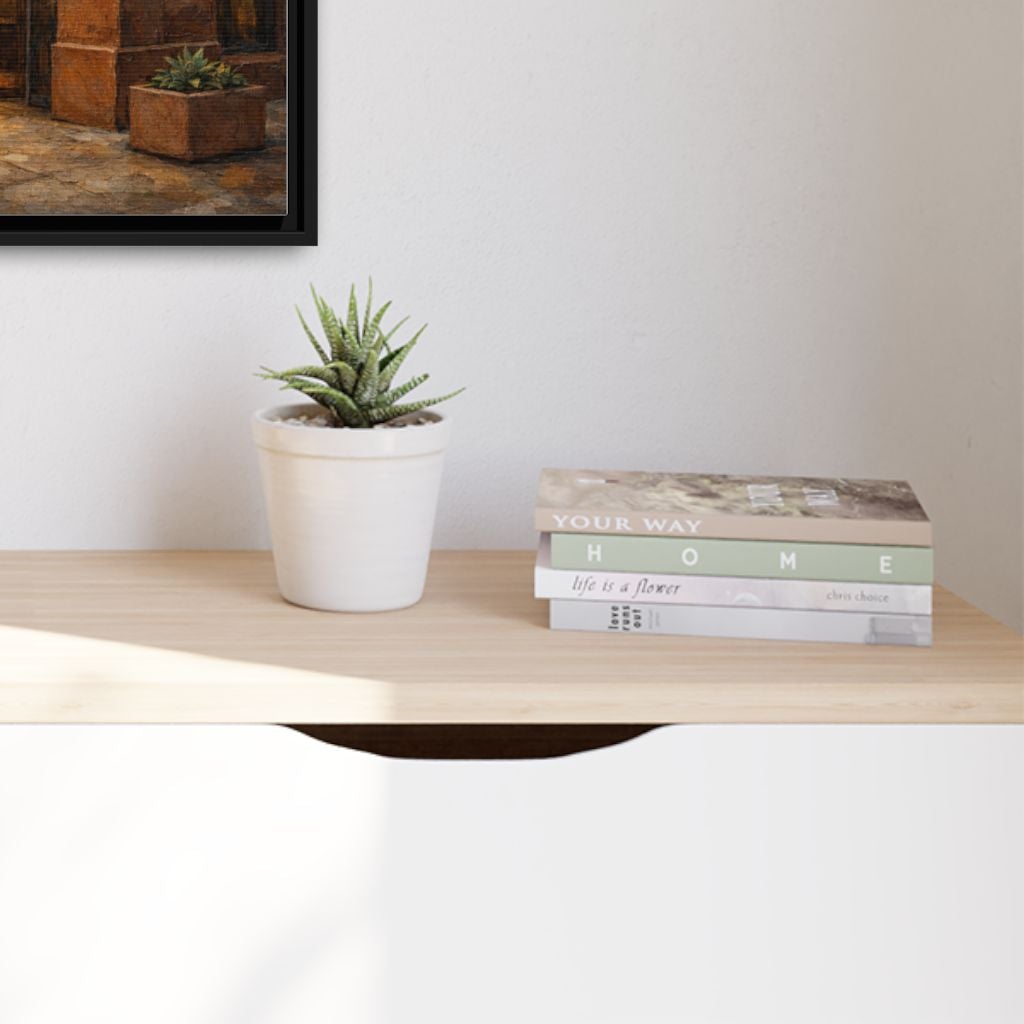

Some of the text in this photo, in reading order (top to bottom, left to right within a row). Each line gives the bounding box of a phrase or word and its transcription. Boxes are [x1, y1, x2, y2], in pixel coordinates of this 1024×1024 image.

[552, 514, 703, 533] YOUR WAY
[572, 575, 681, 599] life is a flower
